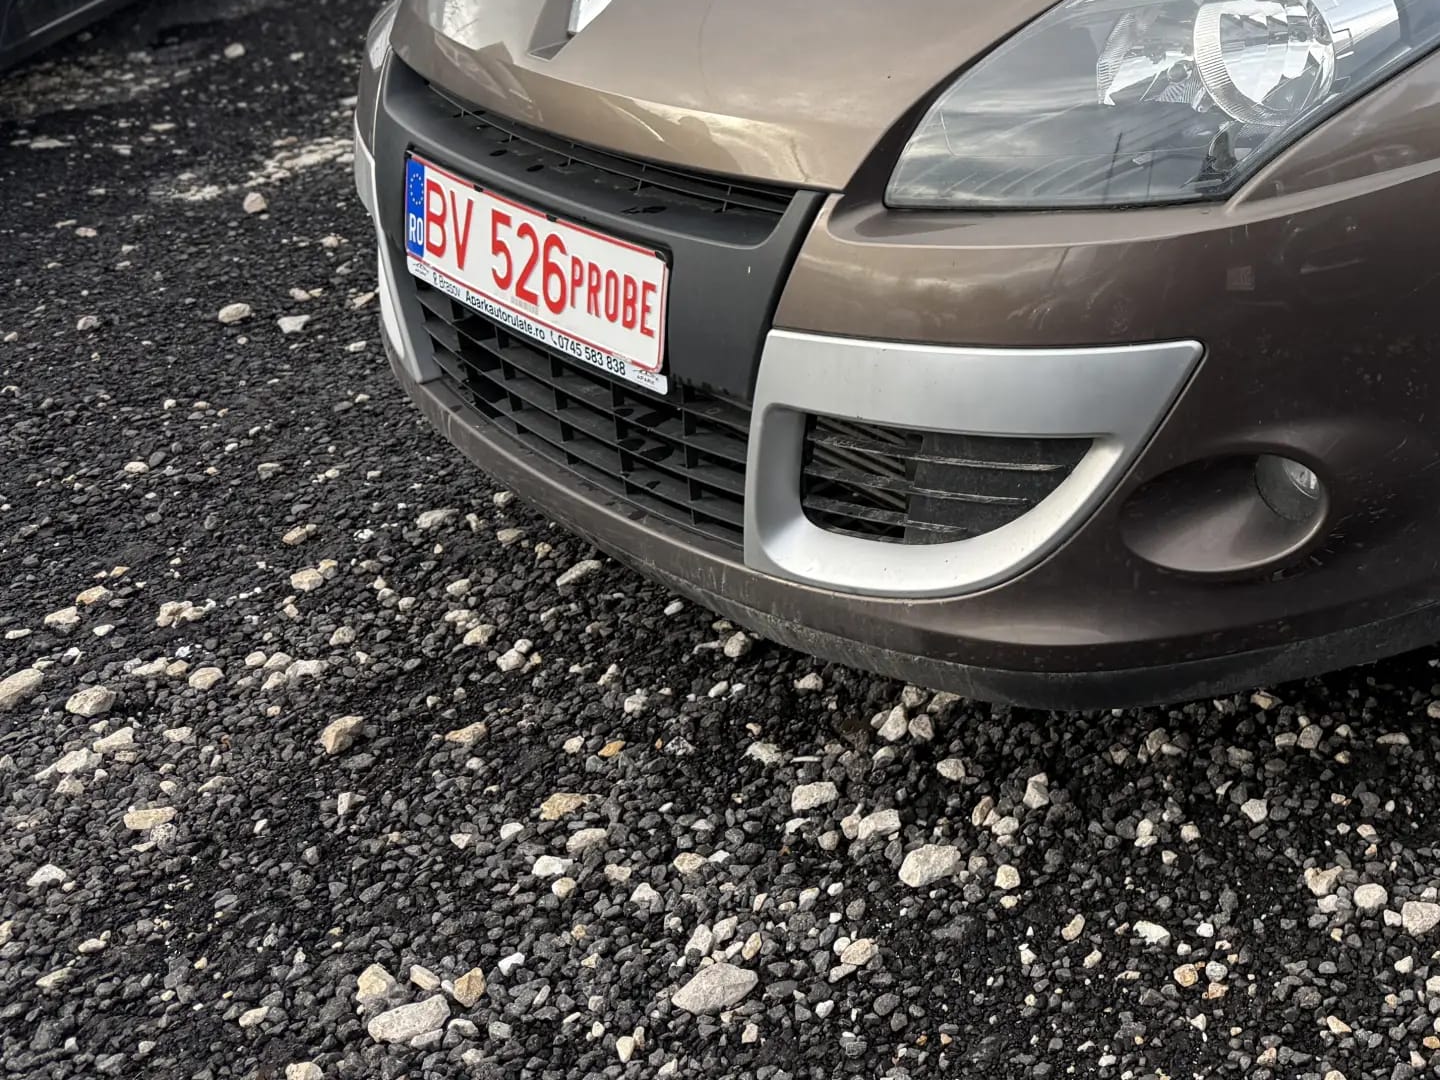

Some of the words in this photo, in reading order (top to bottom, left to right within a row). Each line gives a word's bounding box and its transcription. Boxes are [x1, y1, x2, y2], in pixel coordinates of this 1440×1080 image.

[409, 213, 424, 246] RO
[425, 178, 474, 270] BV
[491, 208, 568, 315] 526
[570, 255, 657, 338] PROBE
[557, 336, 582, 357] 0745
[585, 348, 604, 367] 583
[606, 355, 626, 375] 838
